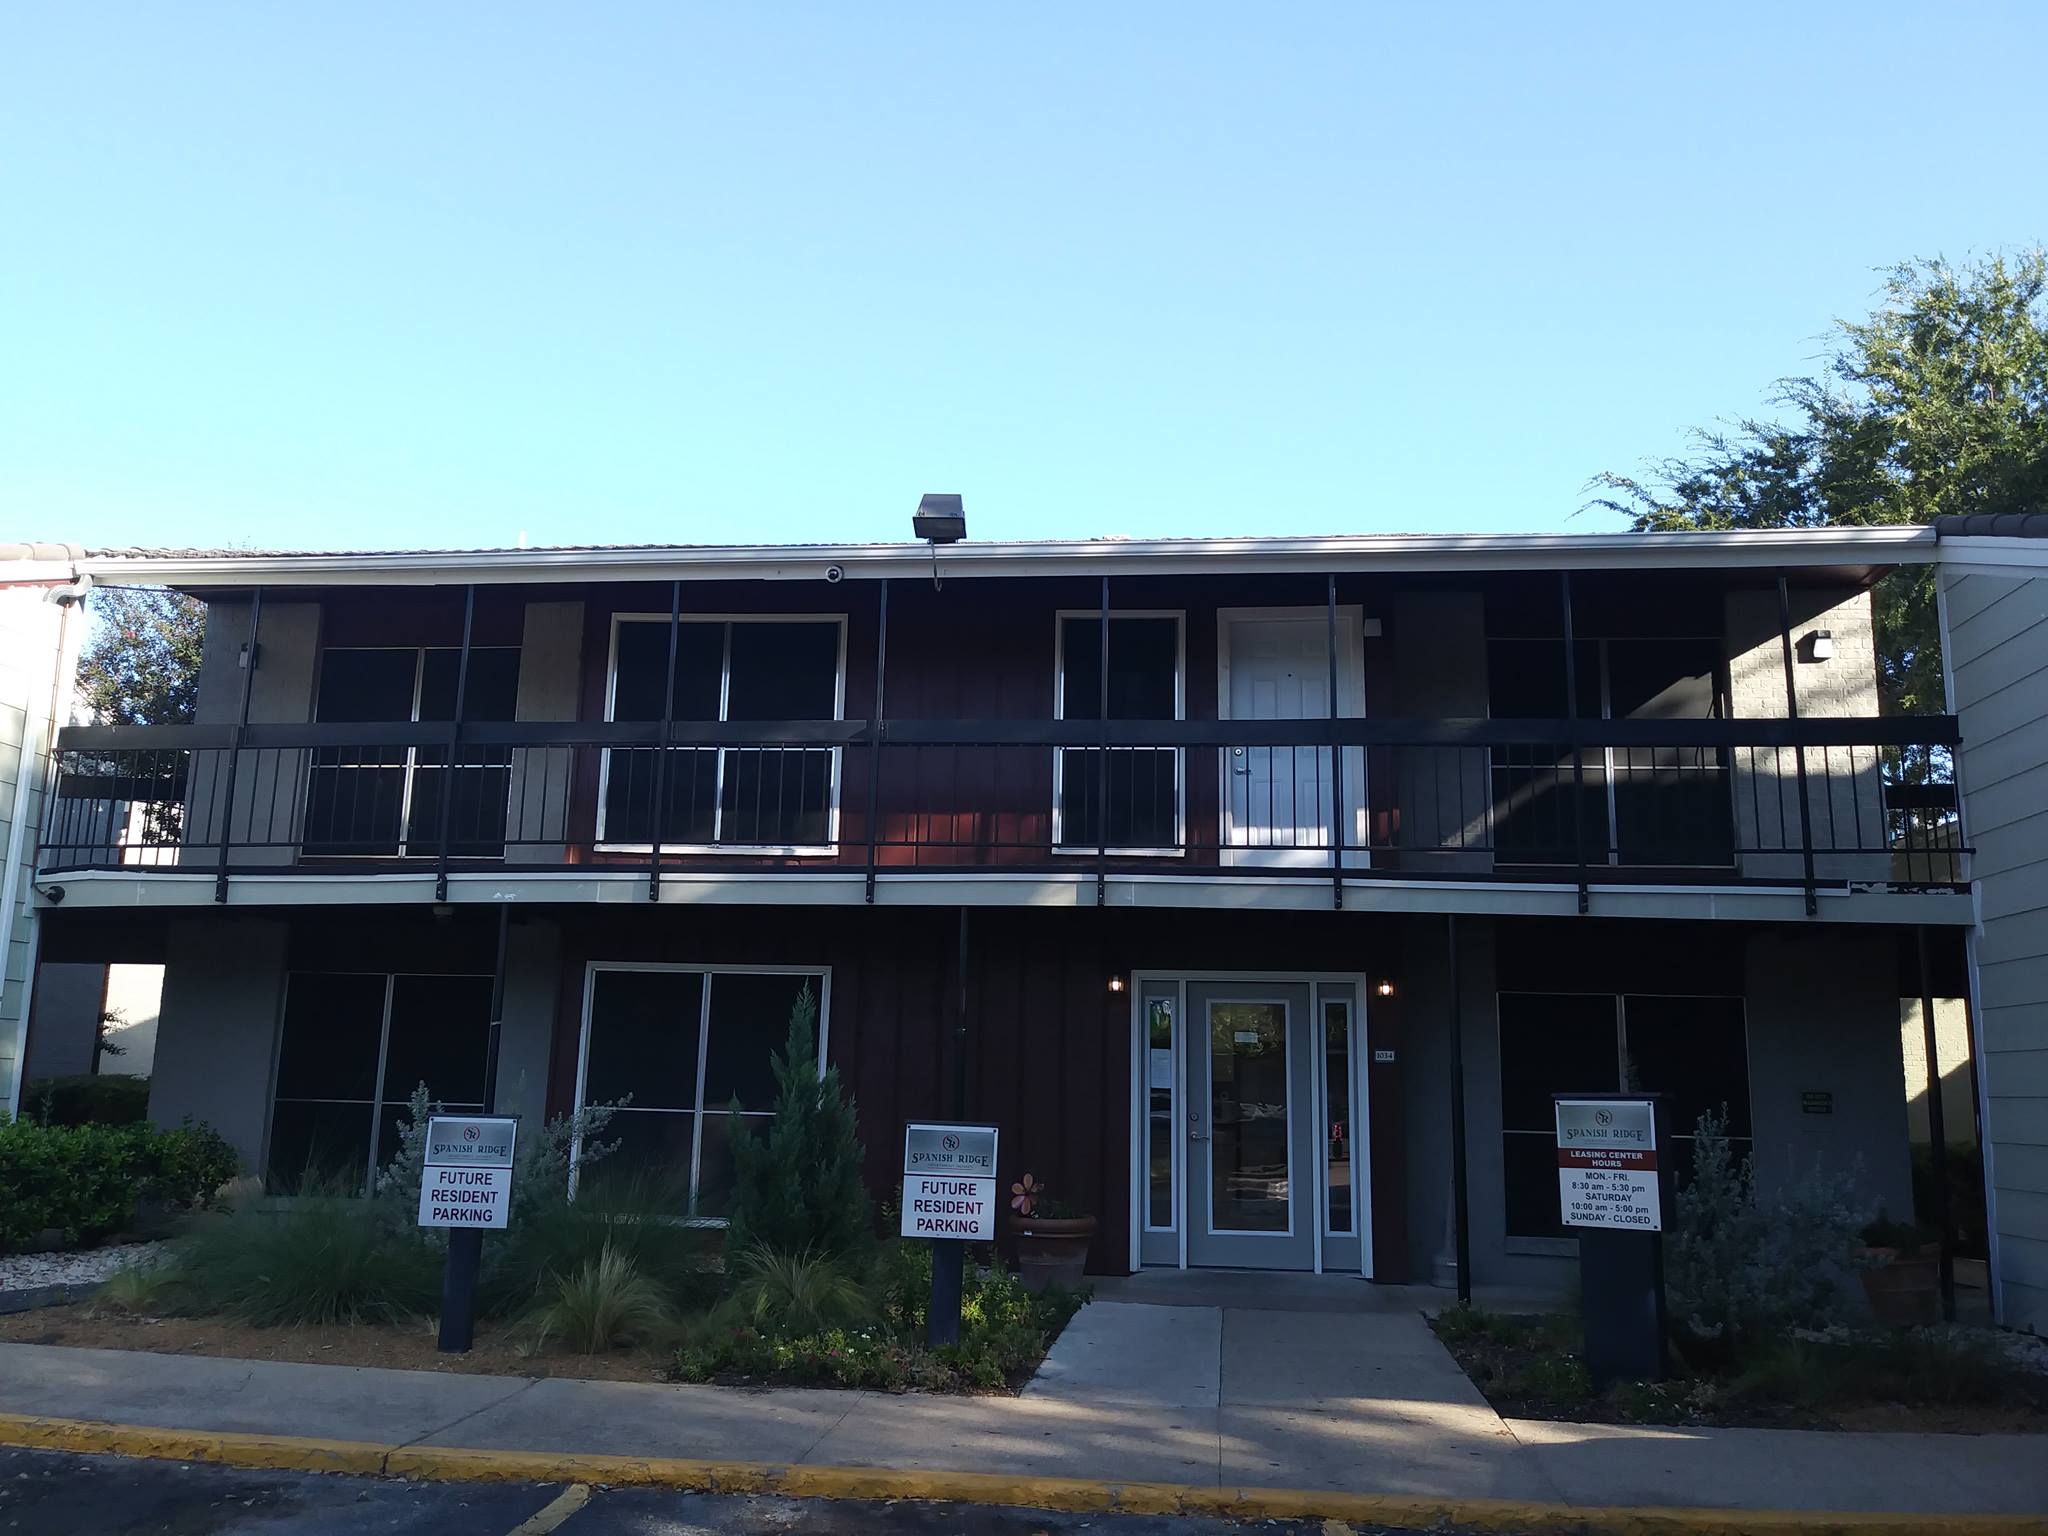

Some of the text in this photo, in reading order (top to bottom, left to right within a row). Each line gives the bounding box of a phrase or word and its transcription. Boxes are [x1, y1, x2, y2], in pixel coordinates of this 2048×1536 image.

[1567, 1128, 1607, 1140] SPANISH
[1613, 1129, 1644, 1142] RIDGE
[433, 1144, 507, 1157] SPANISH RIDGE
[912, 1152, 952, 1164] SPANISH
[958, 1154, 989, 1167] RIDGE
[440, 1172, 492, 1186] FUTURE
[1614, 1173, 1630, 1181] FRI.
[922, 1182, 976, 1196] FUTURE
[1572, 1182, 1589, 1190] 8:30
[1612, 1184, 1629, 1192] 5:30
[431, 1189, 498, 1204] RESIDENT
[1586, 1192, 1632, 1202] SATURDAY
[914, 1200, 984, 1214] RESIDENT
[1571, 1202, 1592, 1210] 10:00
[1615, 1204, 1632, 1212] 5:00
[1636, 1206, 1648, 1214] pm
[432, 1208, 492, 1222] PARKING
[1570, 1212, 1606, 1220] SUNDAY
[1614, 1214, 1650, 1224] CLOSED
[916, 1218, 978, 1234] PARKING
